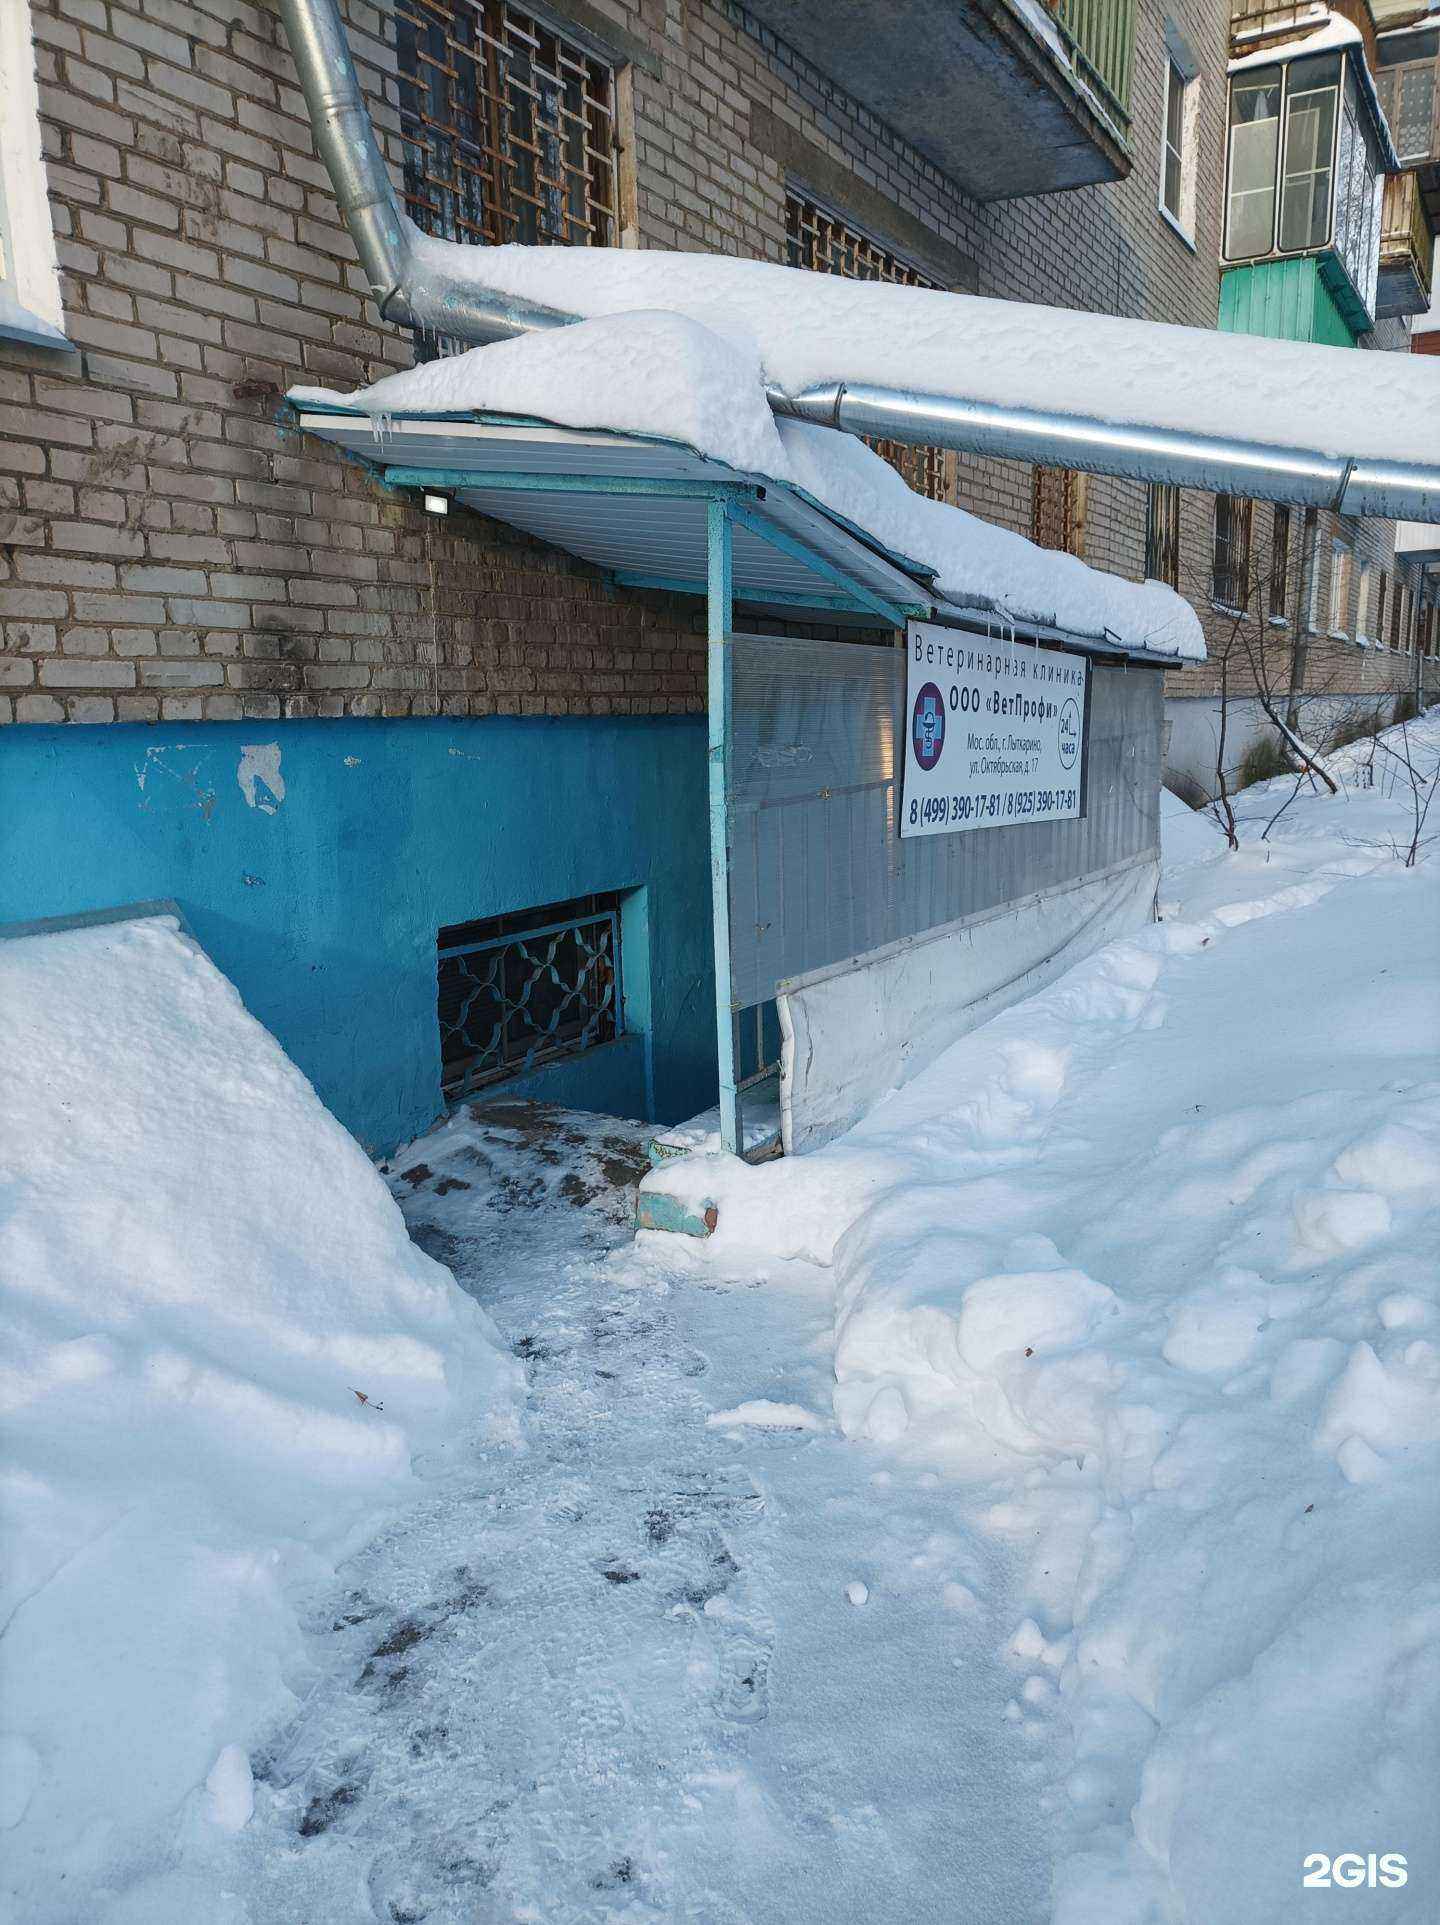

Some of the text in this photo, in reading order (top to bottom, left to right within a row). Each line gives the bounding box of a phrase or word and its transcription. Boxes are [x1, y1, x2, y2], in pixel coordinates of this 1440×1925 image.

[1033, 663, 1082, 686] клиника
[950, 685, 1057, 723] ООО «ВетПрофи»
[1060, 718, 1069, 735] 24
[1061, 742, 1076, 754] часа
[909, 798, 918, 825] 8
[920, 795, 950, 828] (499)
[951, 794, 1001, 821] 390-17-81
[1015, 790, 1037, 818] (925)
[1036, 789, 1077, 812] 390-17-81
